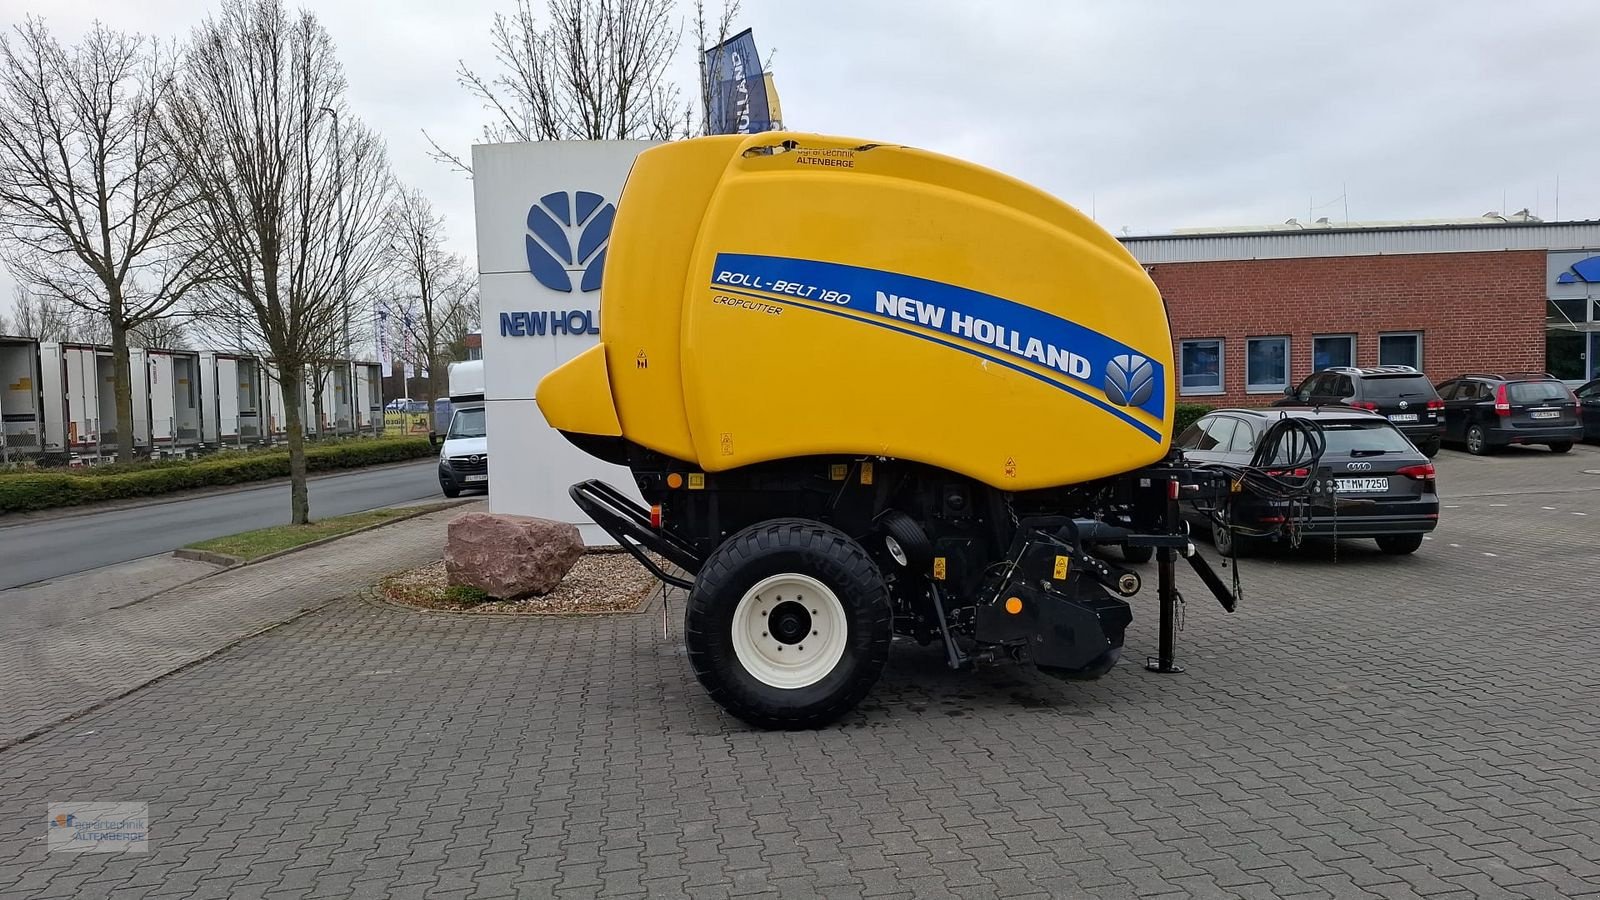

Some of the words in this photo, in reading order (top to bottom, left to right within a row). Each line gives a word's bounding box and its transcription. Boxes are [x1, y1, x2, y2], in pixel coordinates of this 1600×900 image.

[797, 156, 854, 168] ALTENBERGE
[713, 295, 783, 315] CROPCUTTER
[819, 289, 851, 304] 180
[500, 311, 547, 337] NEW
[551, 310, 600, 336] HOL
[875, 291, 945, 328] NEW
[951, 311, 1091, 379] HOLLAND
[1352, 479, 1364, 489] MW
[1365, 479, 1387, 489] 7250
